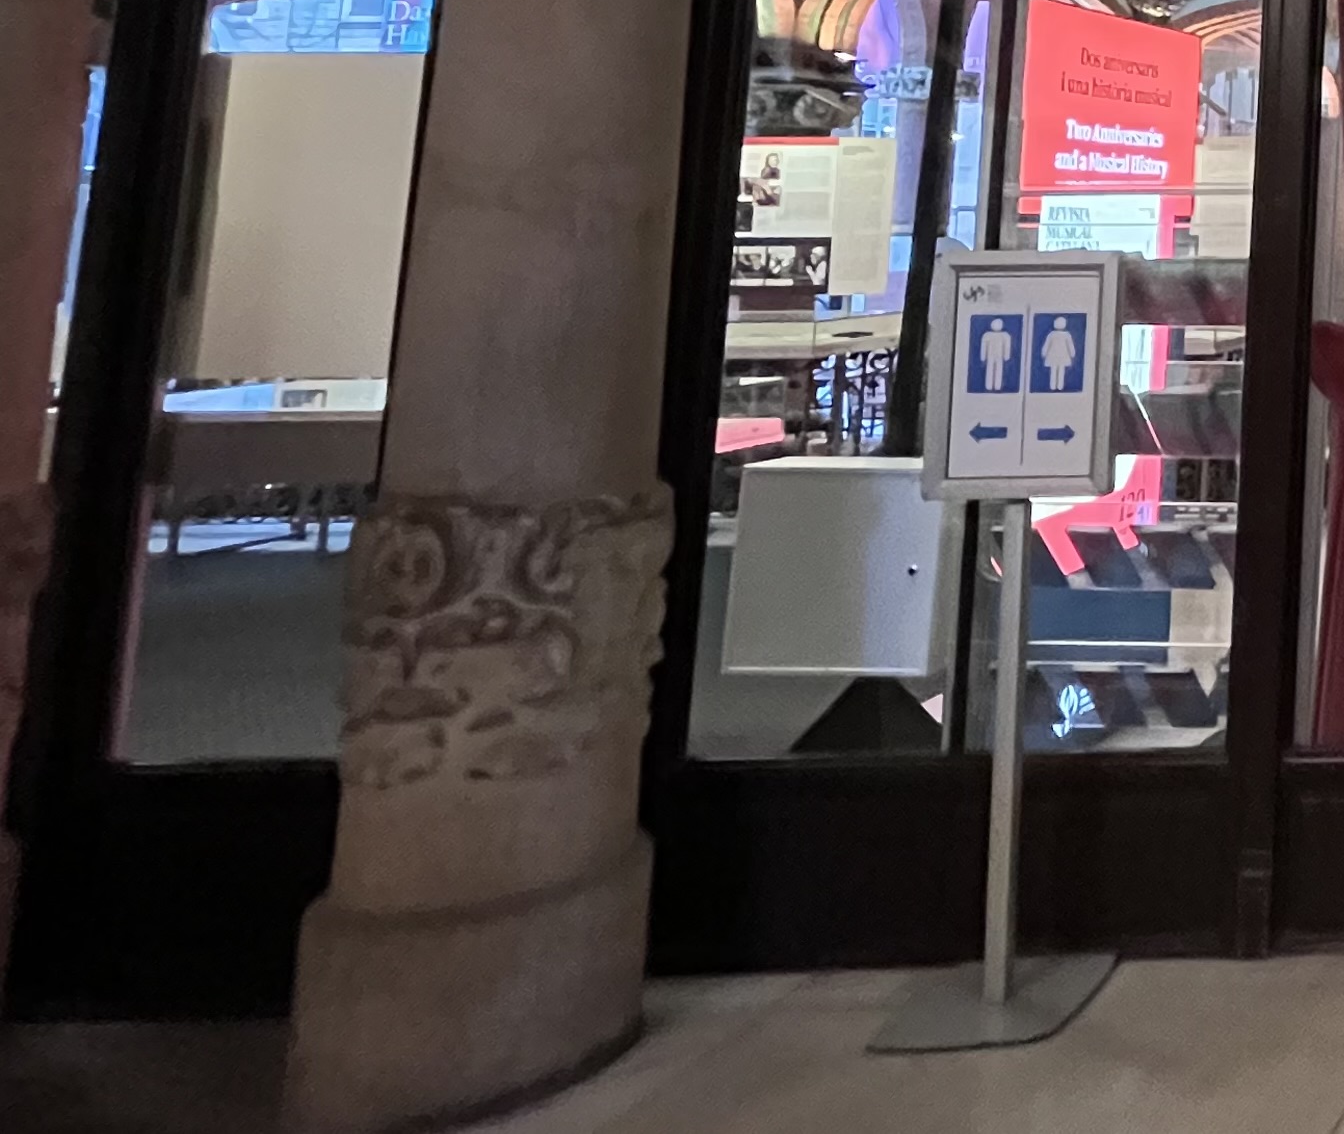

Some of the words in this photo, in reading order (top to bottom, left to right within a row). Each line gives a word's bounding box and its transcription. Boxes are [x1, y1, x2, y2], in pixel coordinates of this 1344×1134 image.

[1080, 46, 1101, 68] Dos
[1067, 78, 1089, 96] una
[1065, 118, 1092, 141] Two
[1092, 123, 1164, 148] Anniversaries
[1054, 148, 1079, 171] and
[1079, 155, 1088, 171] a
[1088, 151, 1130, 174] Musical
[1130, 154, 1168, 180] History
[1044, 225, 1094, 240] MUSICAL
